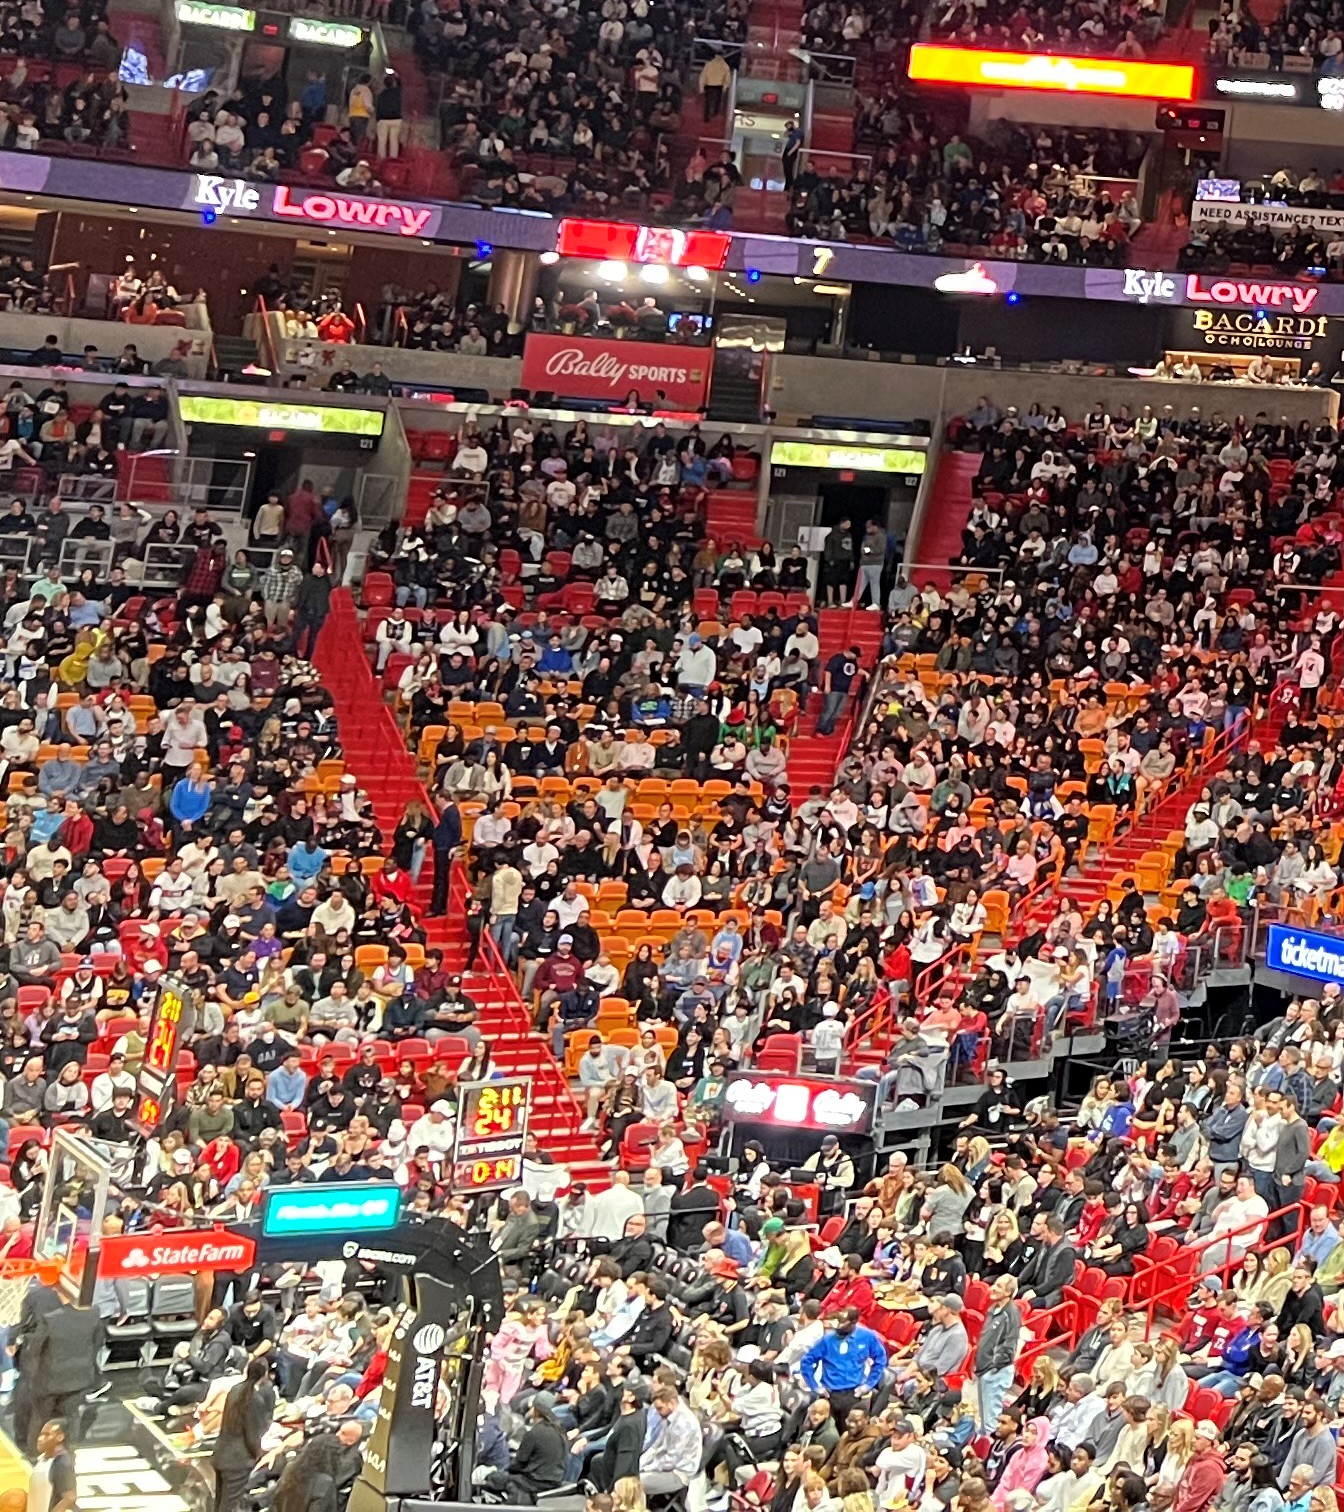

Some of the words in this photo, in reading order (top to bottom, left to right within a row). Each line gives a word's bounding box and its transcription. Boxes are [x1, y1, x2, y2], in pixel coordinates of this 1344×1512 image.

[195, 174, 259, 215] Kyle
[272, 185, 432, 236] Lowry
[1200, 207, 1231, 219] NEED
[1235, 210, 1316, 226] ASSISTANCE?
[812, 248, 834, 275] 7
[1123, 269, 1175, 305] Kyle
[1186, 274, 1318, 312] Lowry
[1205, 335, 1252, 347] OCHO
[1258, 338, 1311, 350] LOUNGE
[546, 348, 629, 387] Bally
[629, 365, 687, 383] SPORTS
[475, 1107, 512, 1135] 24
[411, 1356, 437, 1410] AT&T
